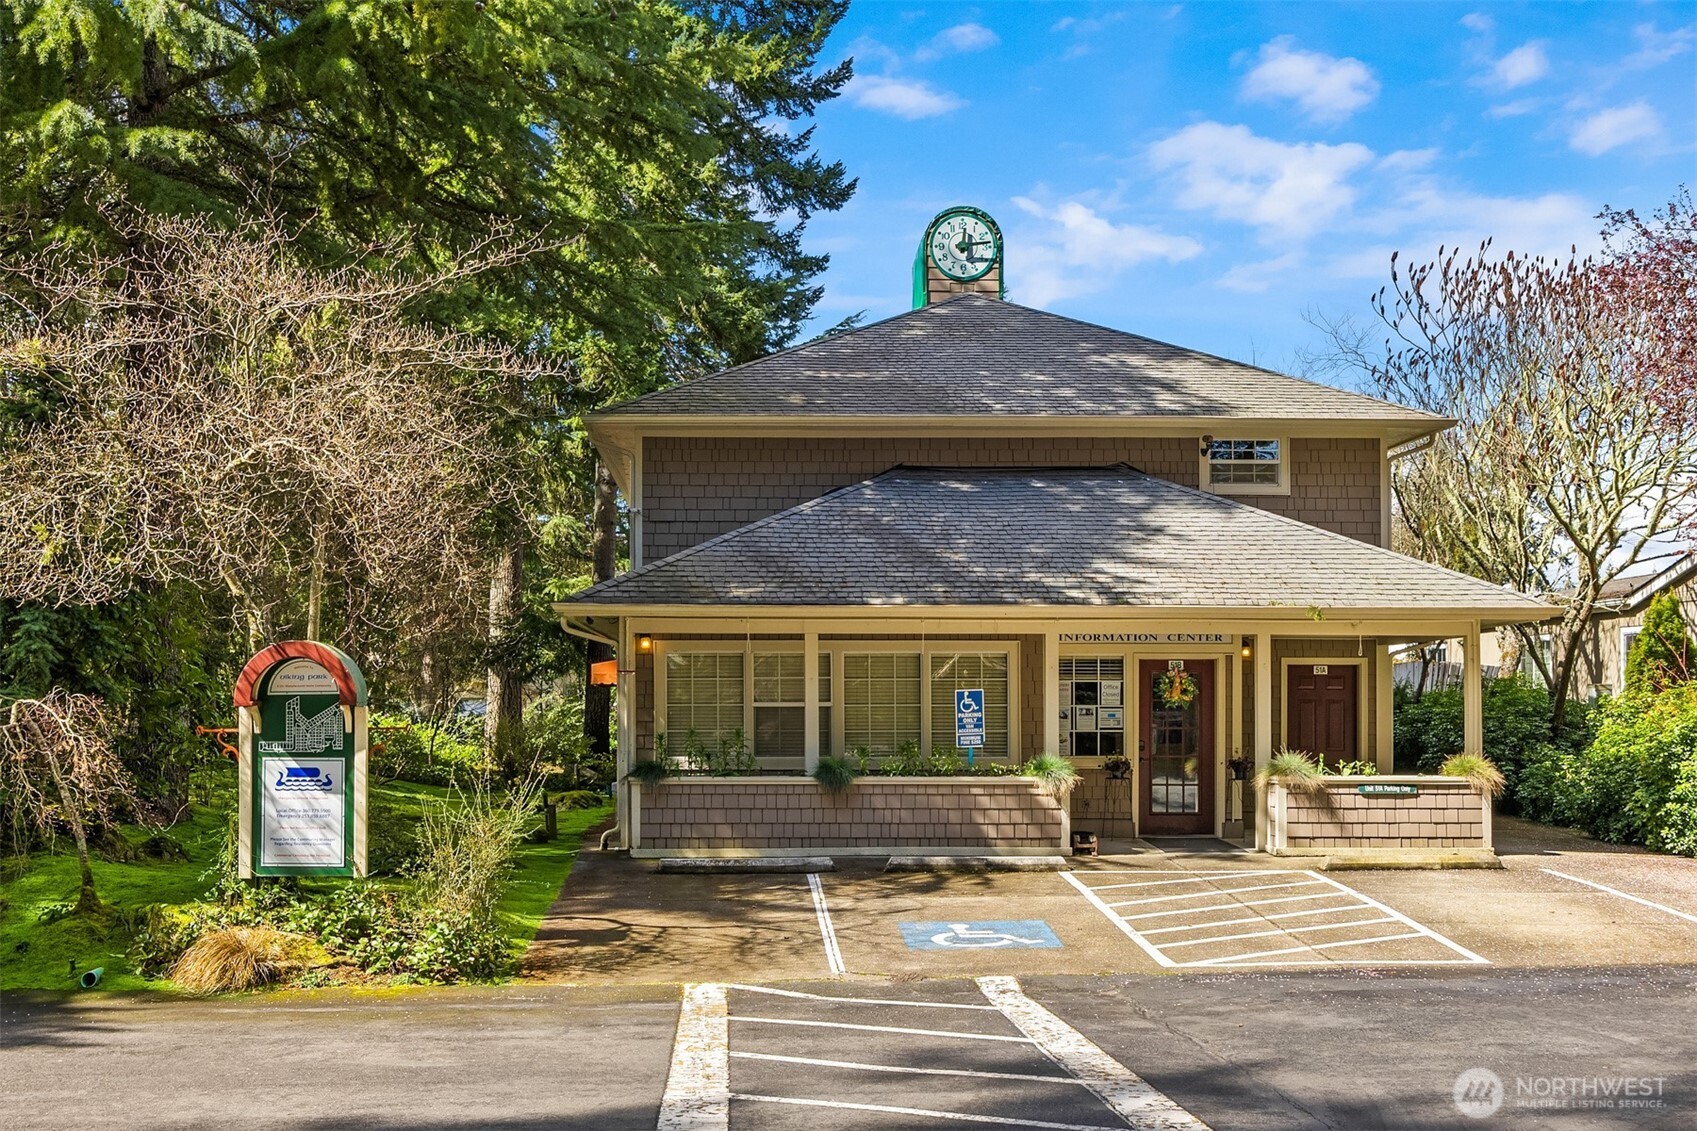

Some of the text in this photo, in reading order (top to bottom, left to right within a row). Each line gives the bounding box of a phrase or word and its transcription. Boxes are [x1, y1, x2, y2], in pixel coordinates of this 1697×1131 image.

[950, 224, 956, 232] 11
[958, 222, 967, 230] 12
[1058, 633, 1223, 642] INFORMATION CENTER
